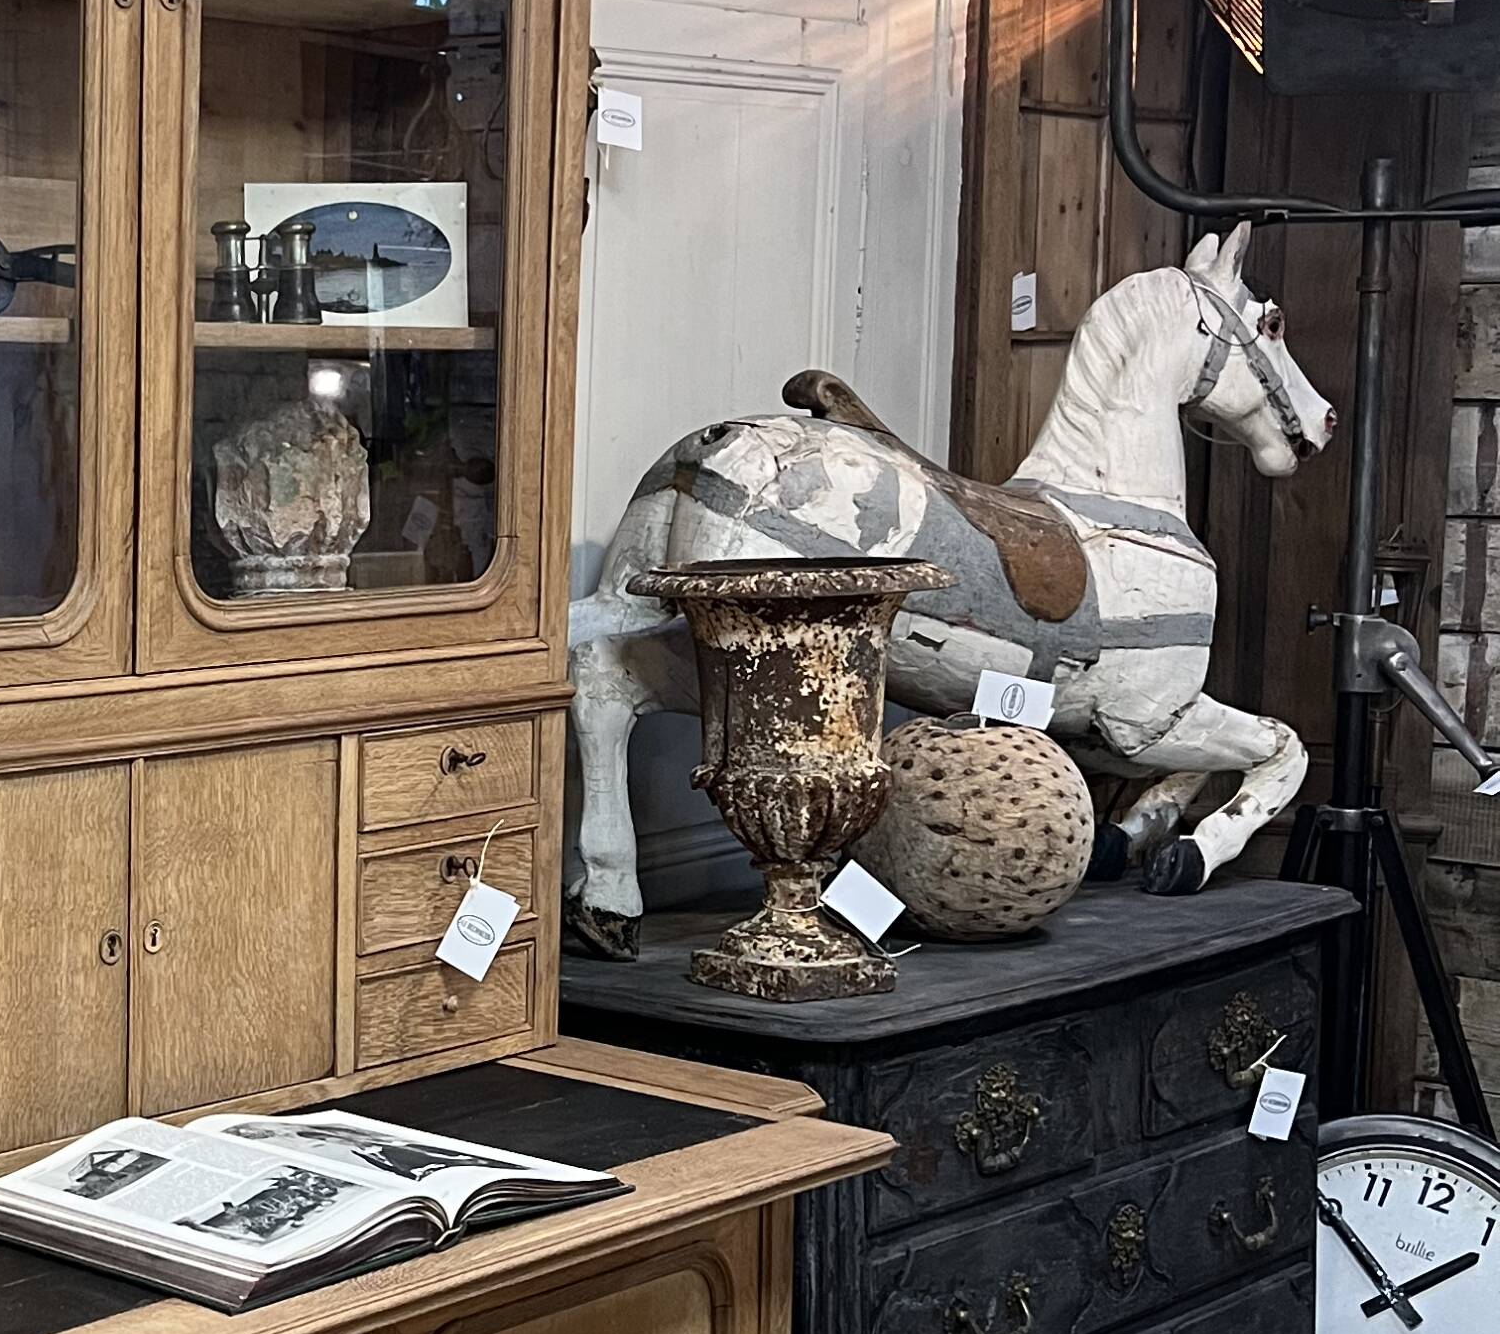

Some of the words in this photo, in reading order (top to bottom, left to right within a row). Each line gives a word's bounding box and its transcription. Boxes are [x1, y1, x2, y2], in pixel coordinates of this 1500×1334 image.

[1363, 1171, 1393, 1208] 11
[1417, 1175, 1455, 1215] 12
[1480, 1216, 1497, 1247] 1
